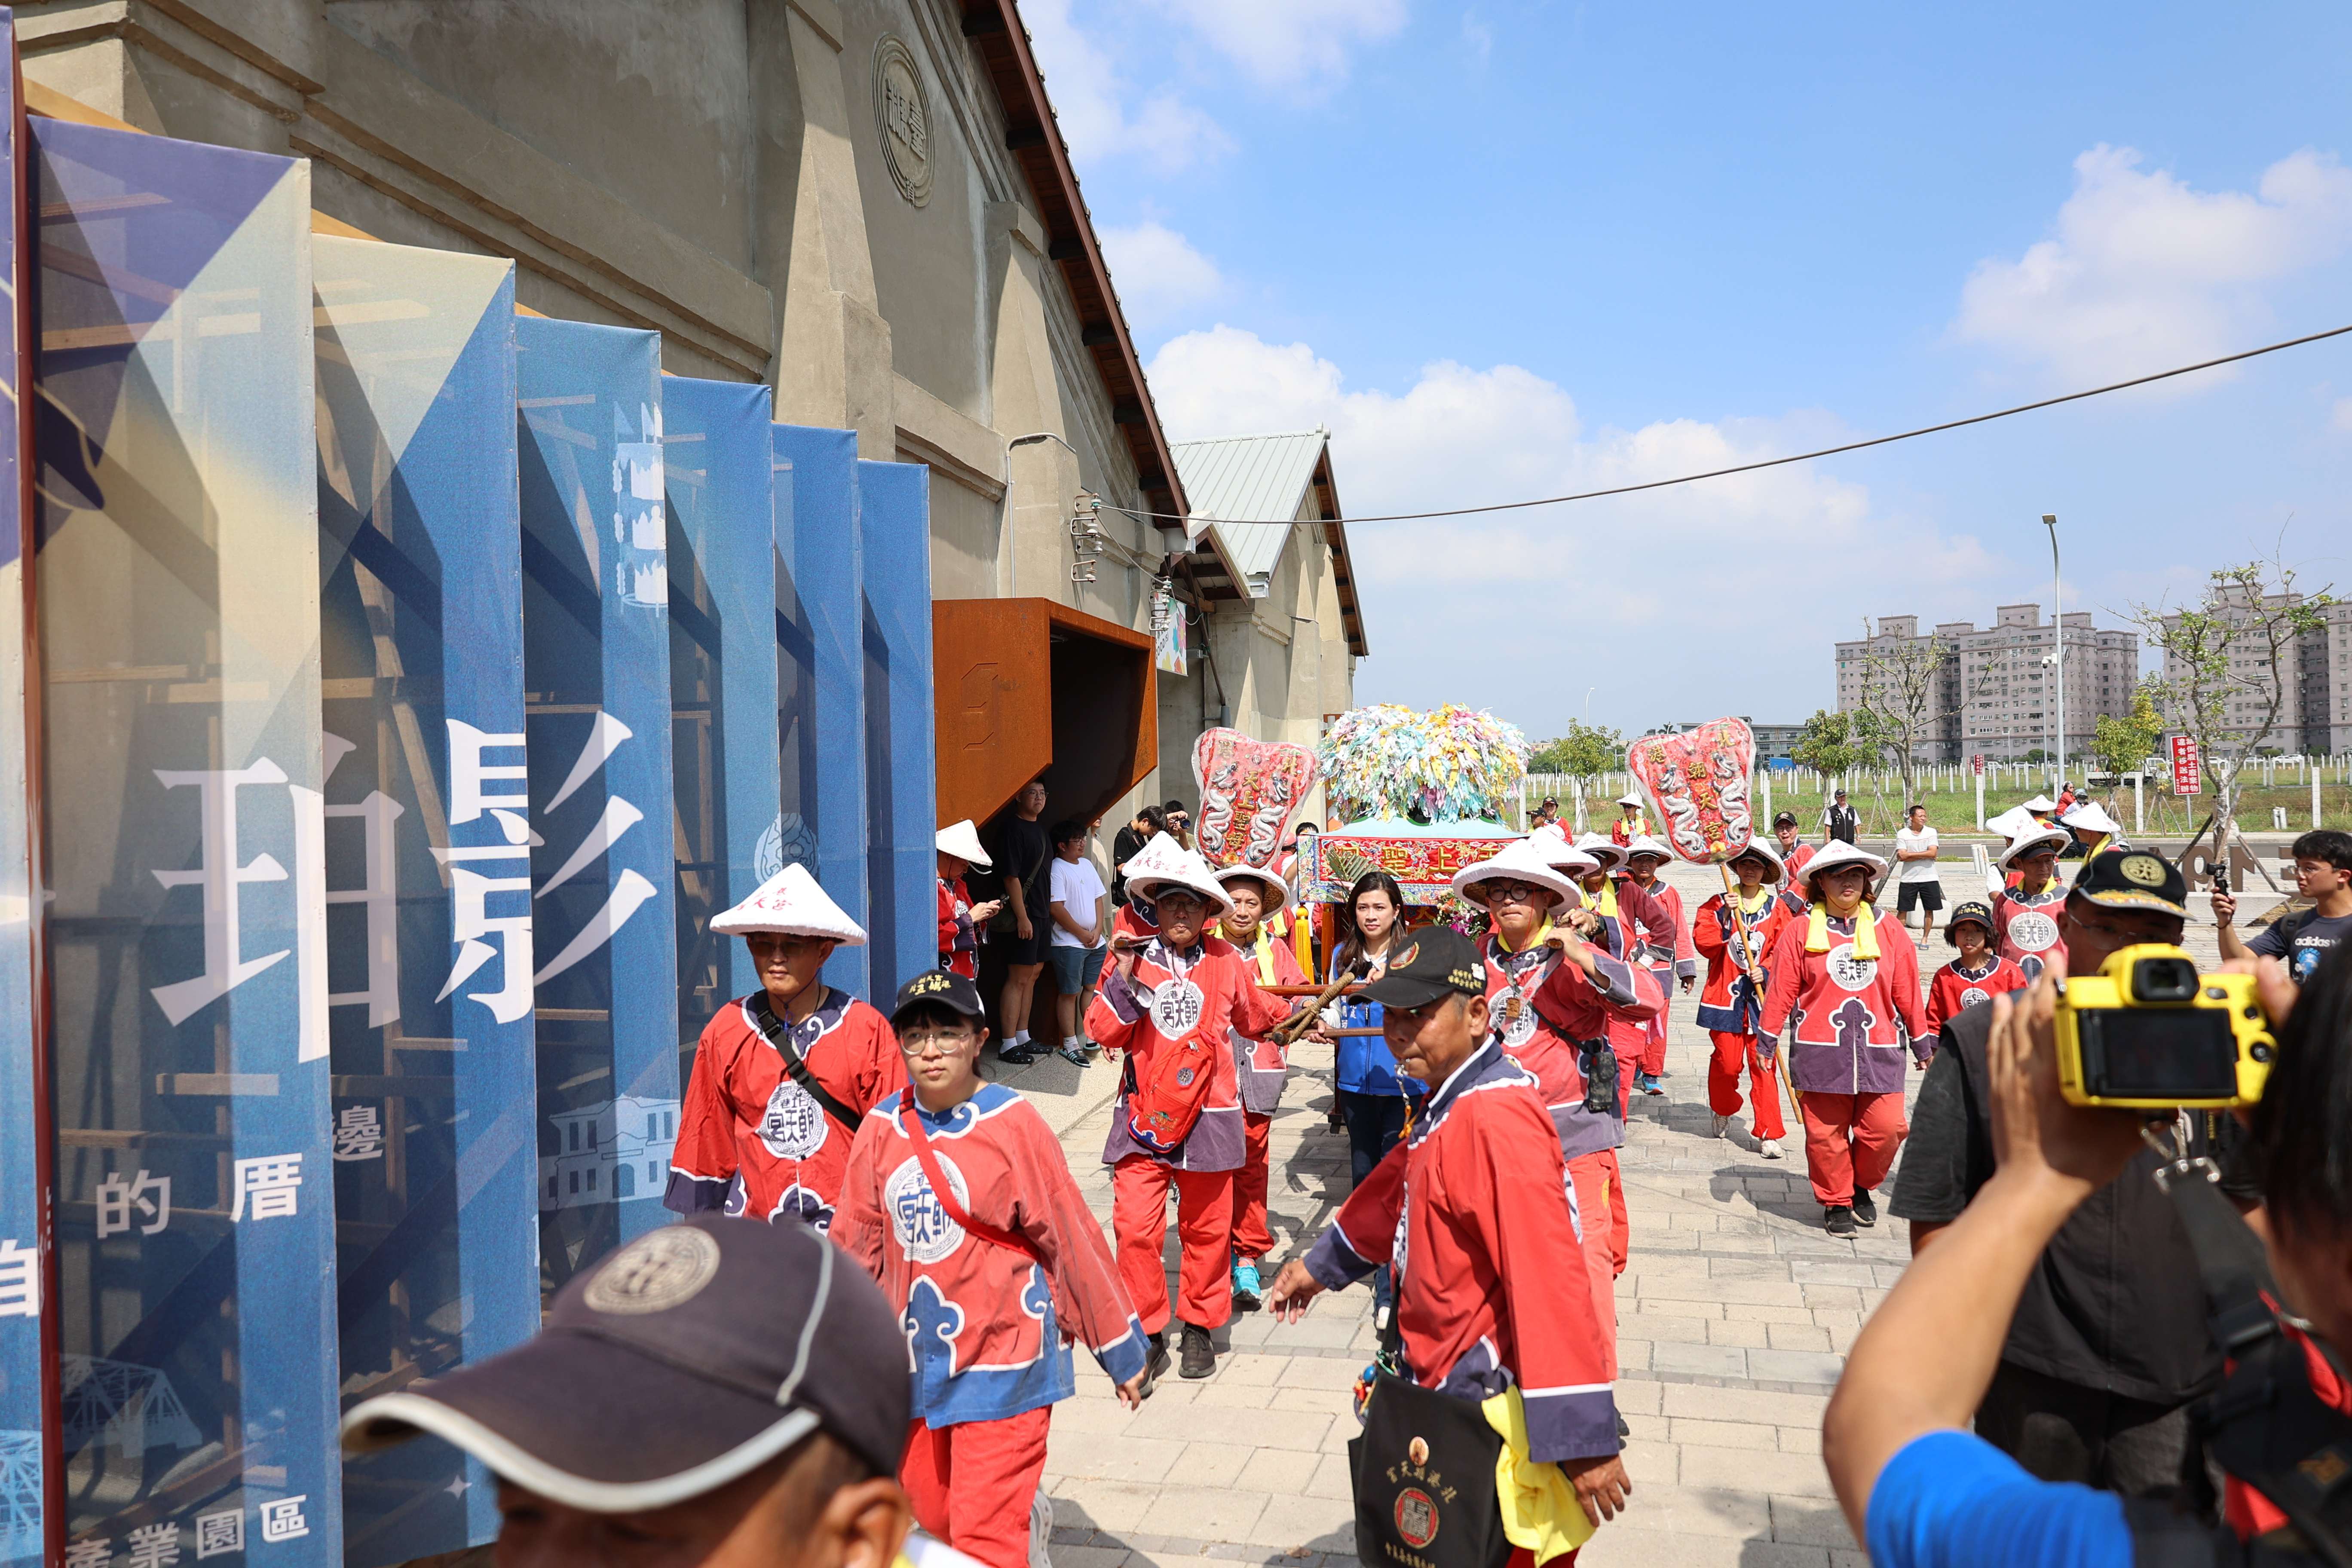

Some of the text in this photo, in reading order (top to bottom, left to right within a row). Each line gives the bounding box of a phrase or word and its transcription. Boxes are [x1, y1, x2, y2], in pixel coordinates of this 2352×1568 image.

[1688, 761, 1723, 841] 朝天宮
[2295, 936, 2331, 947] adidas
[1161, 999, 1198, 1029] 朝天宮
